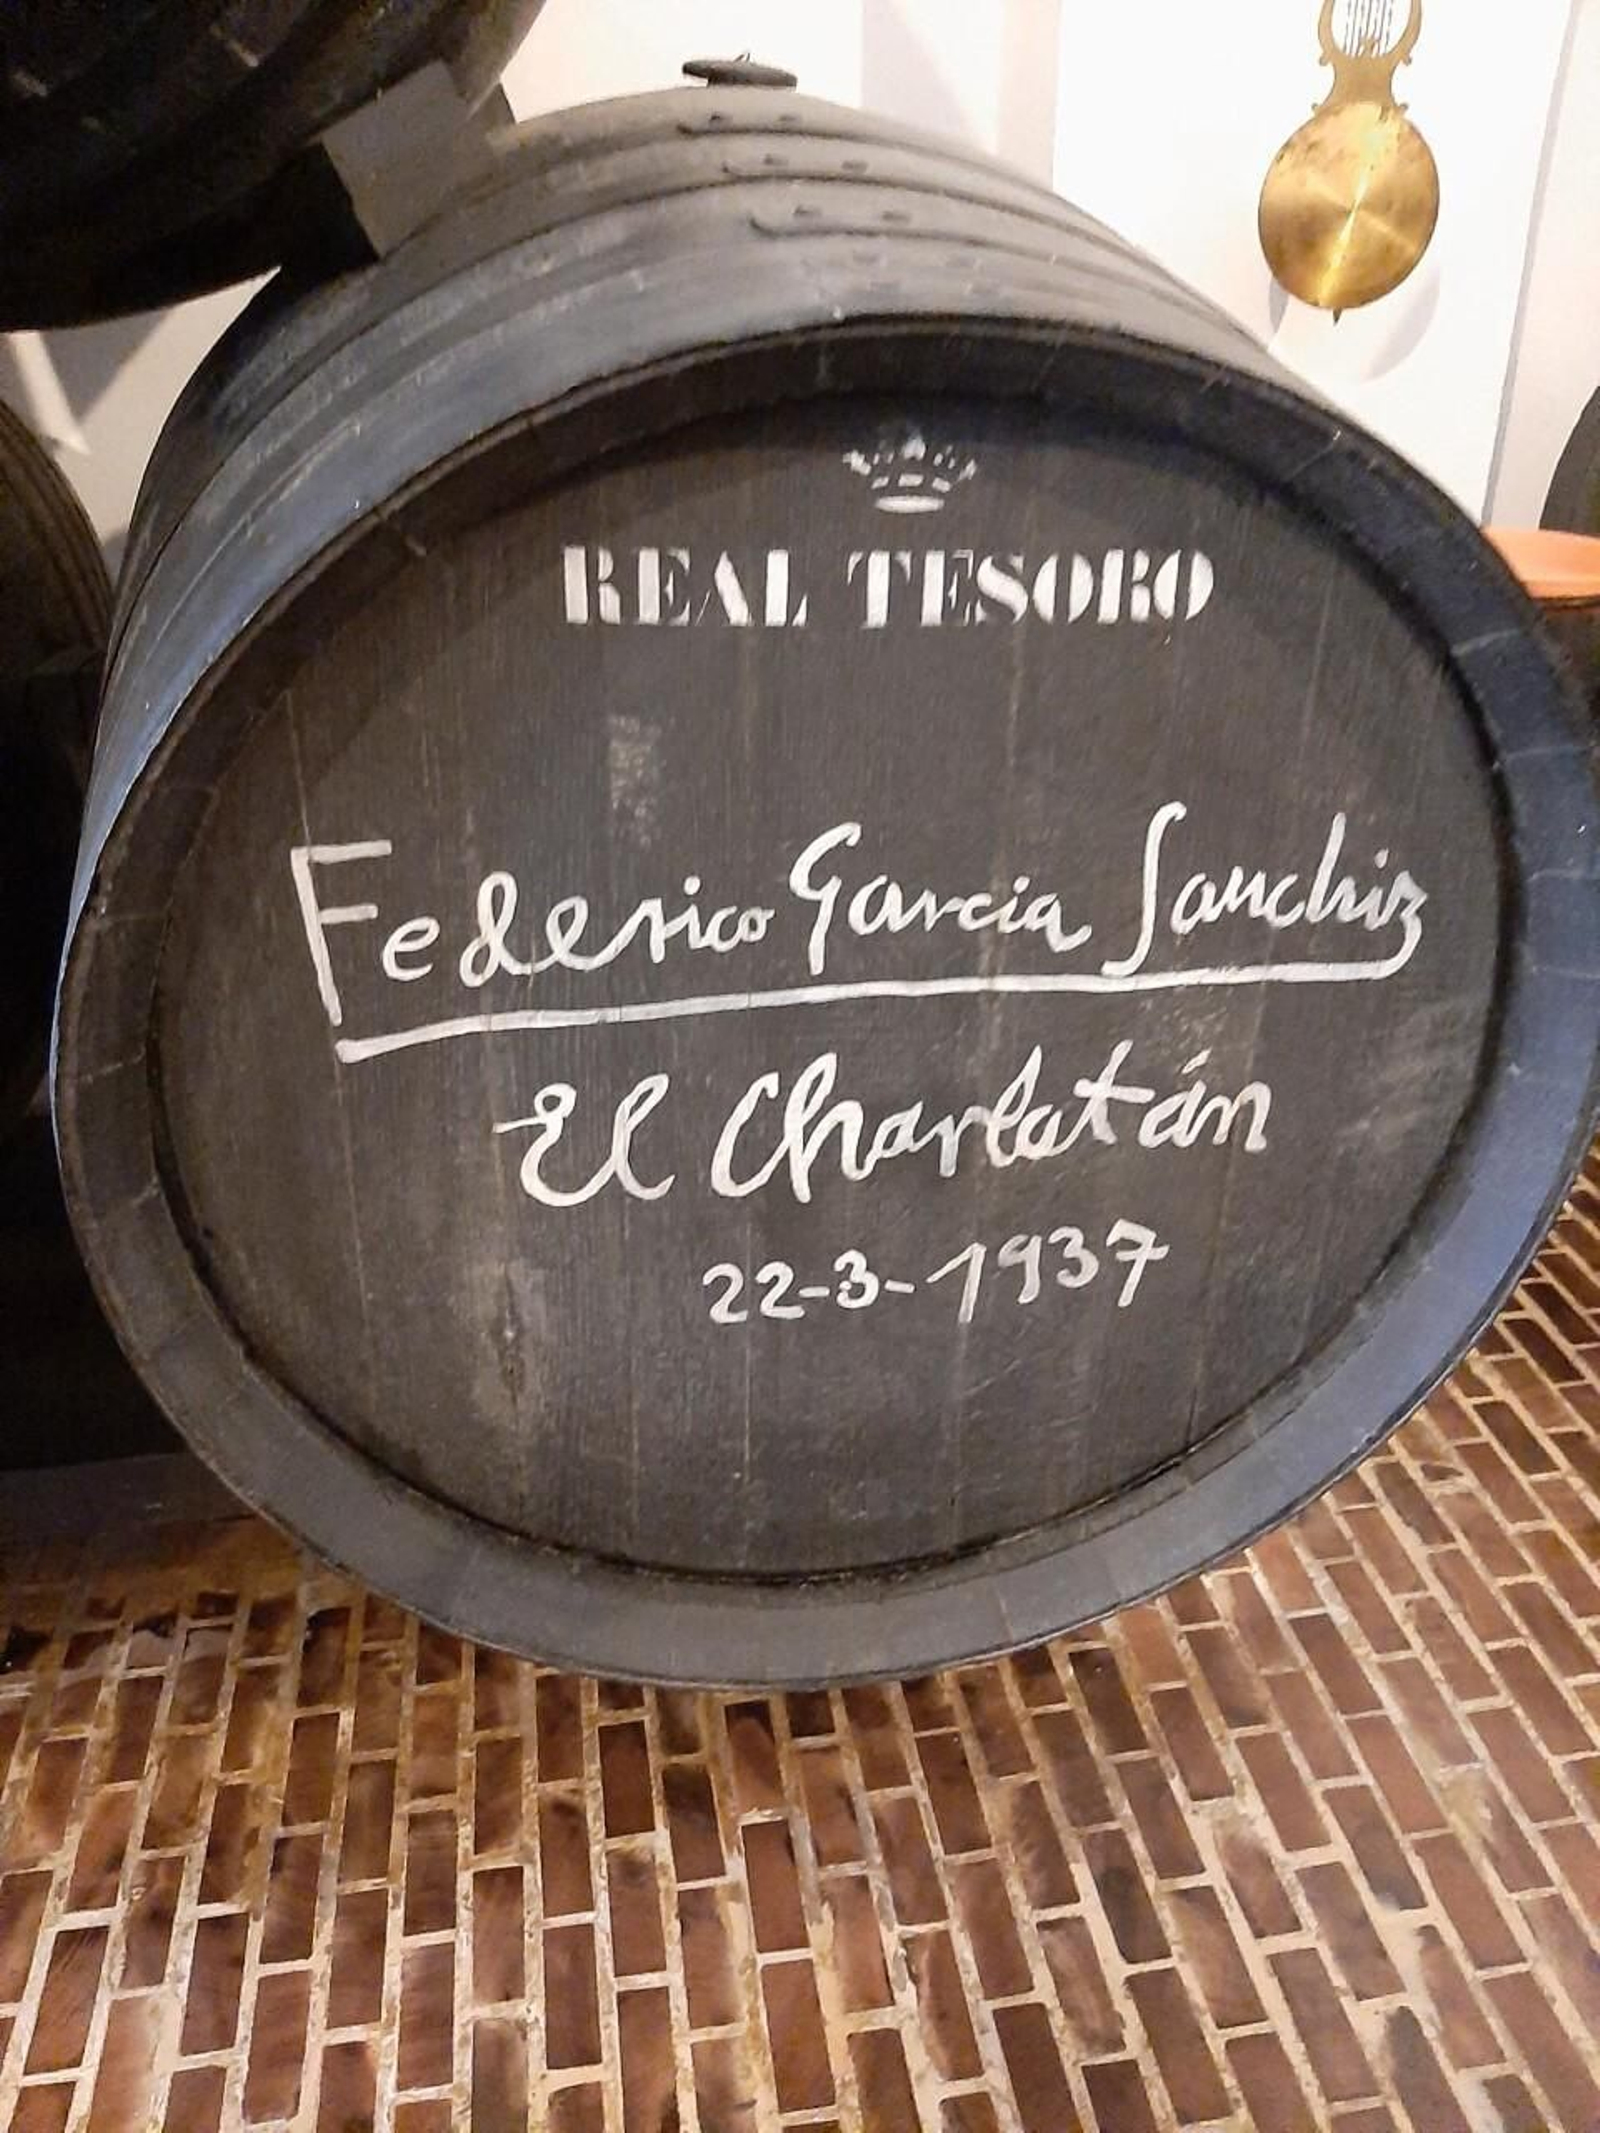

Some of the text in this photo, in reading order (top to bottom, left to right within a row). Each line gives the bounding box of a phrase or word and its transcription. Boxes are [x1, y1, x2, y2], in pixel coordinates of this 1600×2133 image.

[562, 545, 1215, 628] REAL TESORO
[290, 839, 776, 1027] Federico
[1100, 799, 1429, 978] Sanchiz
[491, 1039, 1273, 1208] El Charlatán
[701, 1218, 1171, 1325] 22-3-1937
